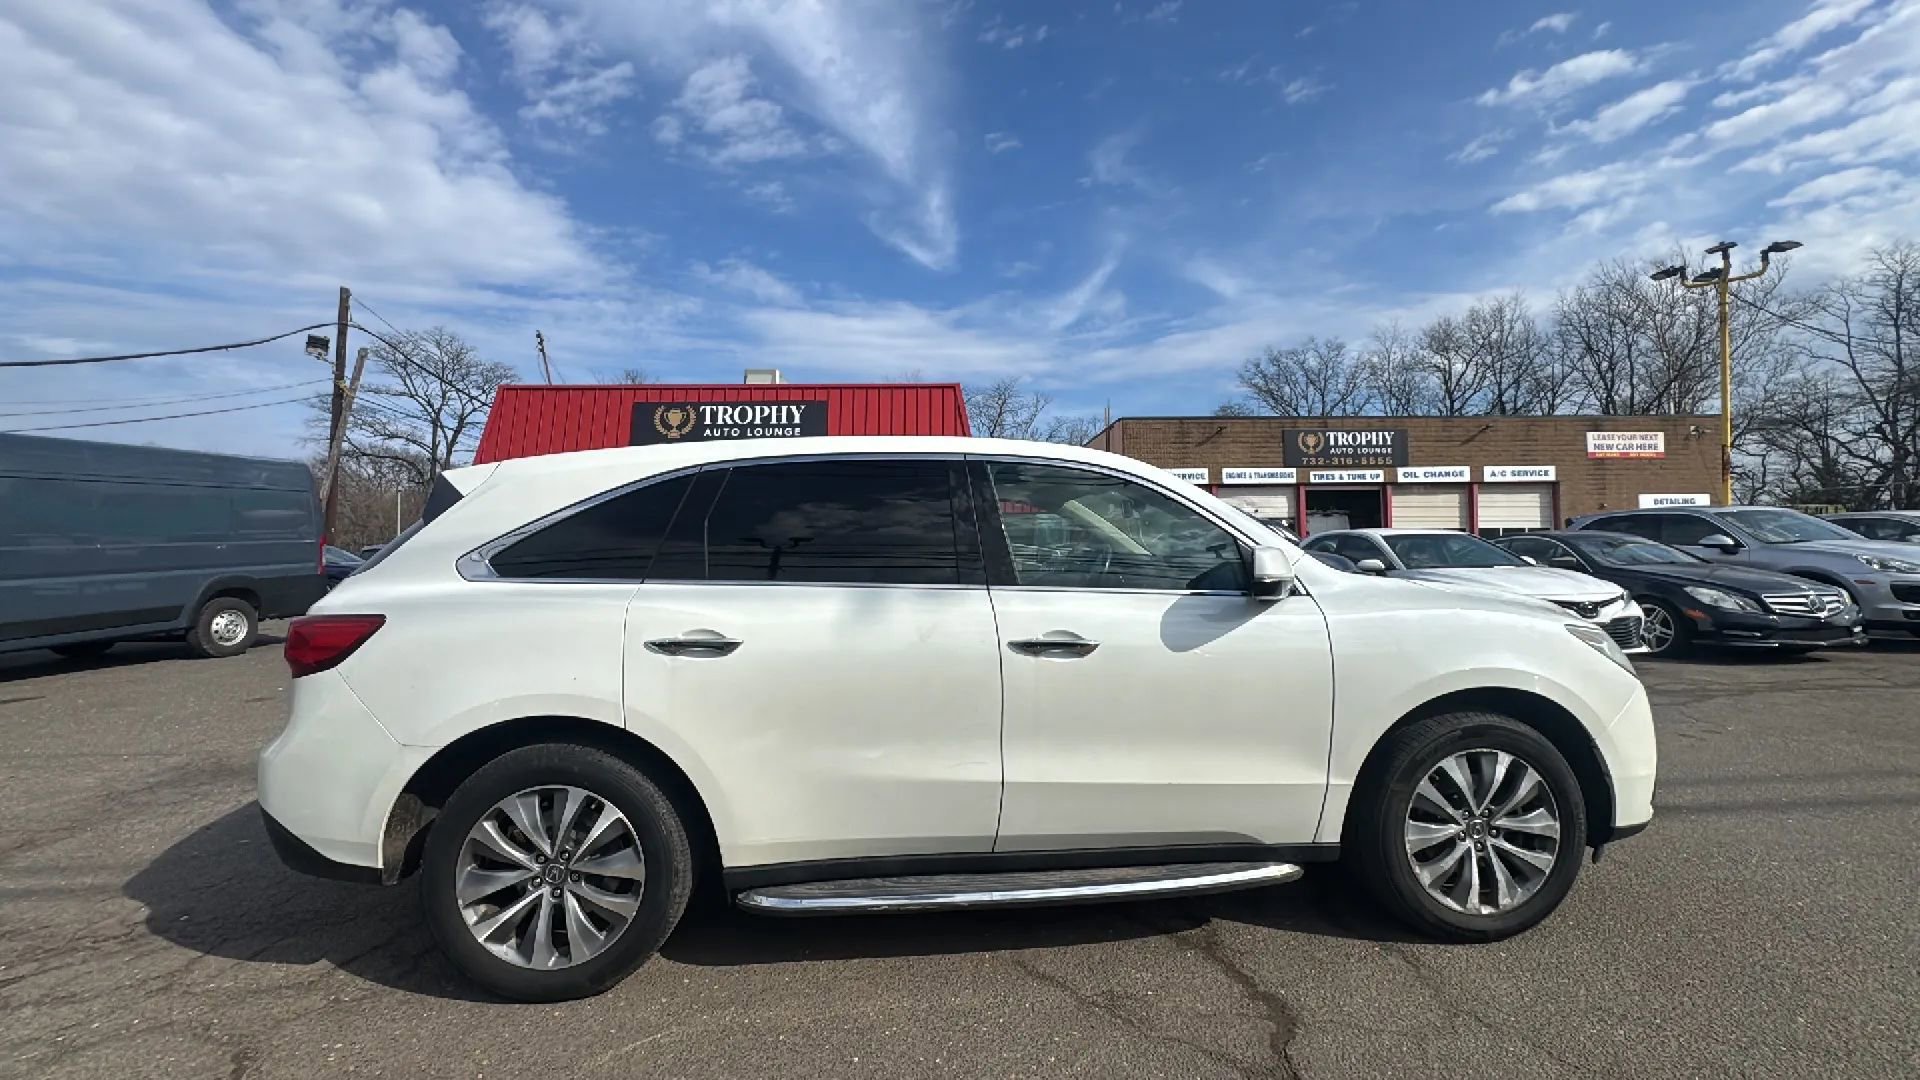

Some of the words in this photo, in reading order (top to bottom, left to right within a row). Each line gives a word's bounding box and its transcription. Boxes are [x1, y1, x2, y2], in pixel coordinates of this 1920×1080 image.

[699, 404, 807, 425] TROPHY
[703, 427, 740, 437] AUTO
[747, 427, 801, 437] LOUNGE
[1325, 431, 1395, 446] TROPHY
[1592, 433, 1616, 441] LEASE
[1616, 433, 1638, 441] YOUR
[1639, 433, 1659, 441] NEXT
[1330, 447, 1354, 455] AUTO
[1357, 447, 1392, 455] LOUNGE
[1593, 443, 1614, 451] NEW
[1615, 443, 1635, 451] CAR
[1636, 443, 1659, 451] HERE
[1302, 457, 1393, 465] 732-316-5555
[1312, 473, 1335, 481] TIRES
[1346, 473, 1367, 481] TUNE
[1369, 473, 1381, 481] UP
[1402, 471, 1419, 479] OIL
[1423, 470, 1465, 478] CHANGE
[1510, 469, 1550, 477] SERVICE
[1653, 497, 1696, 505] DETAILING
